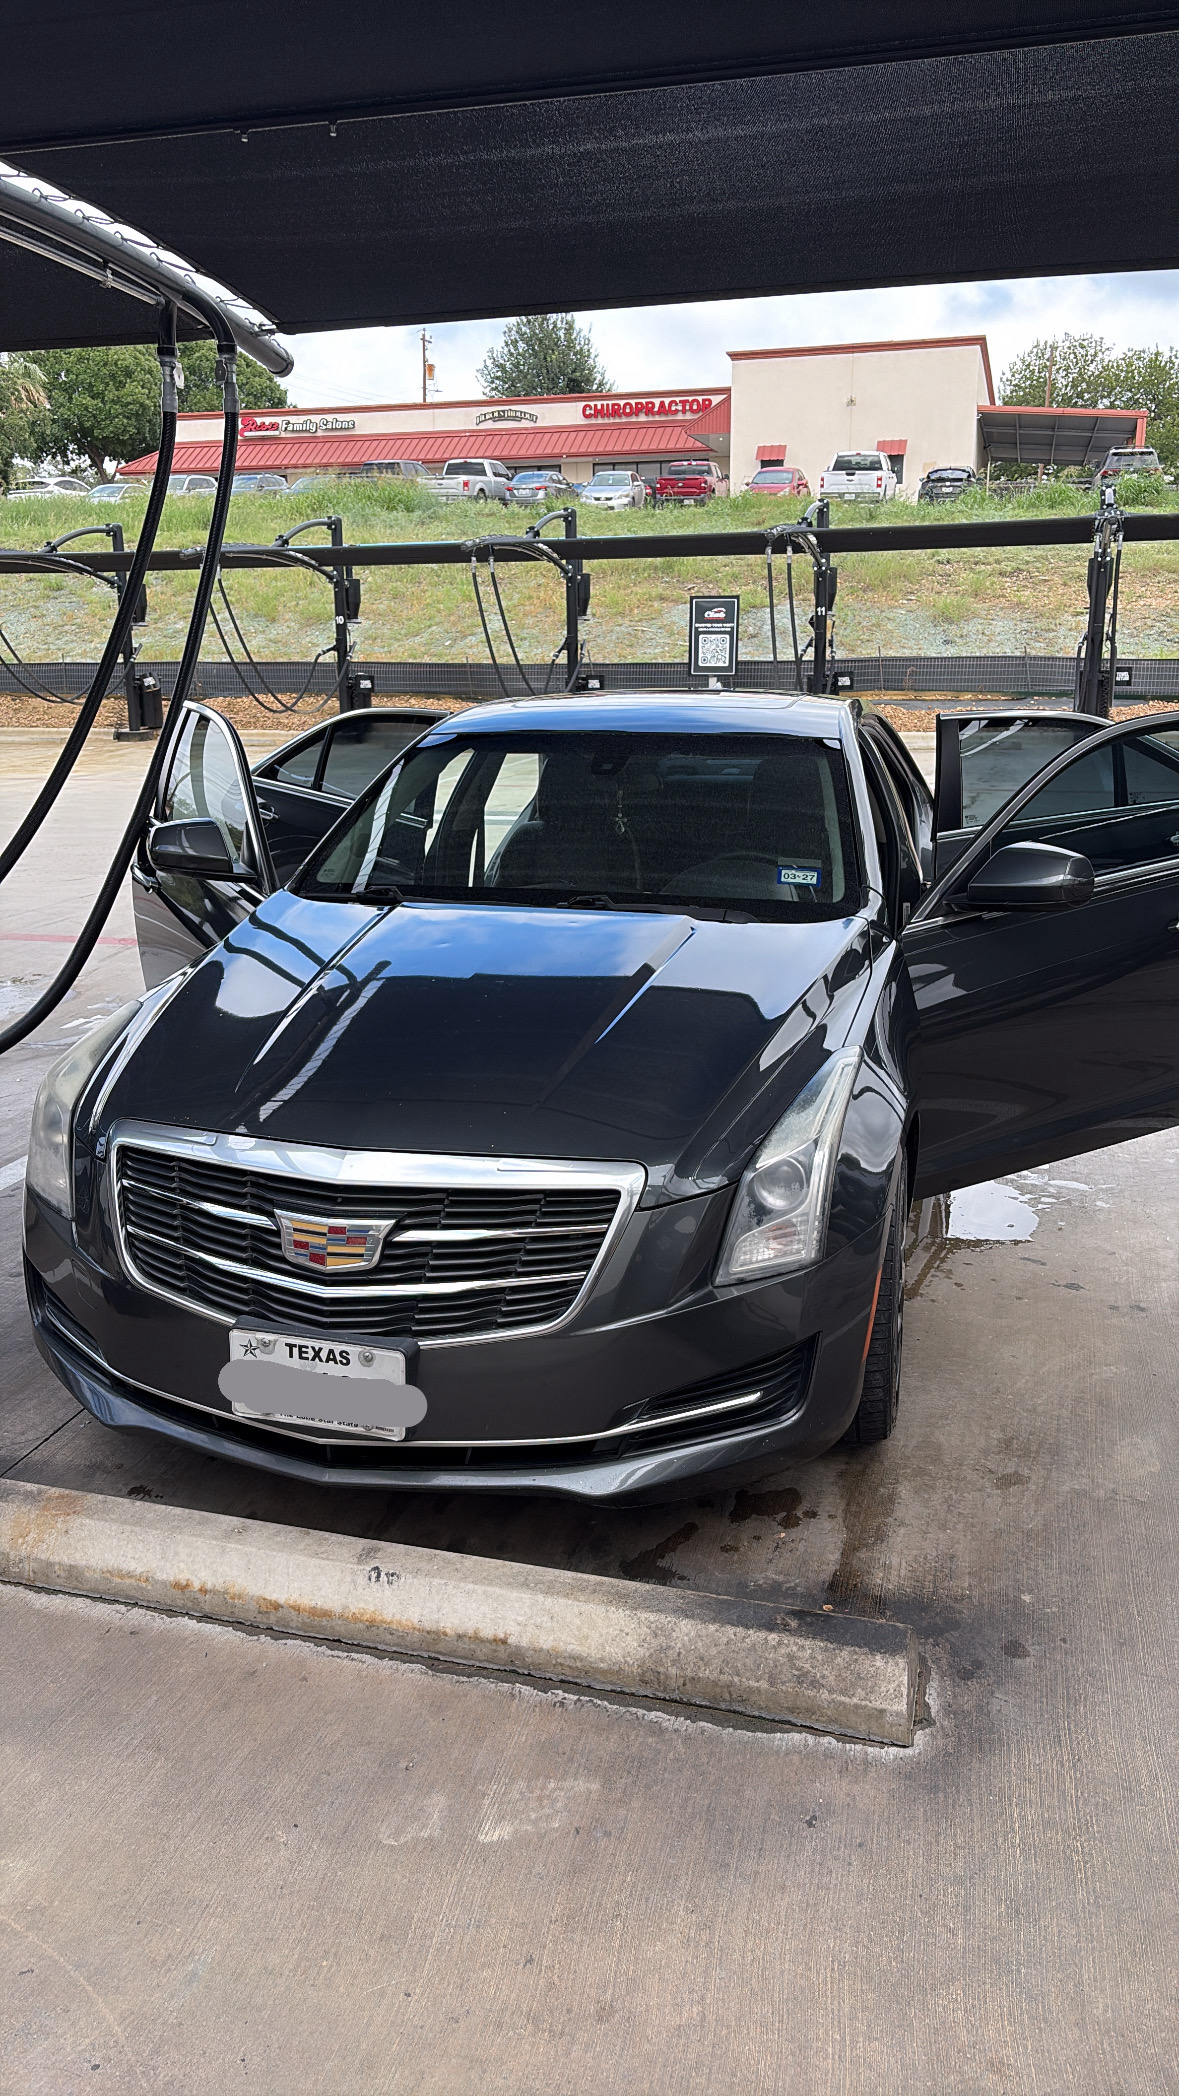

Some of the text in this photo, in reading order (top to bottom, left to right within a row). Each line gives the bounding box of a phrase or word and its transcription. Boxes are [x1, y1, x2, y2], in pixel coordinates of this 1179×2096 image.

[582, 398, 712, 418] CHIROPRACTOR
[281, 419, 317, 433] Family
[319, 418, 355, 431] Salons
[817, 606, 826, 616] 11
[335, 615, 344, 624] 10
[284, 1342, 351, 1367] TEXAS
